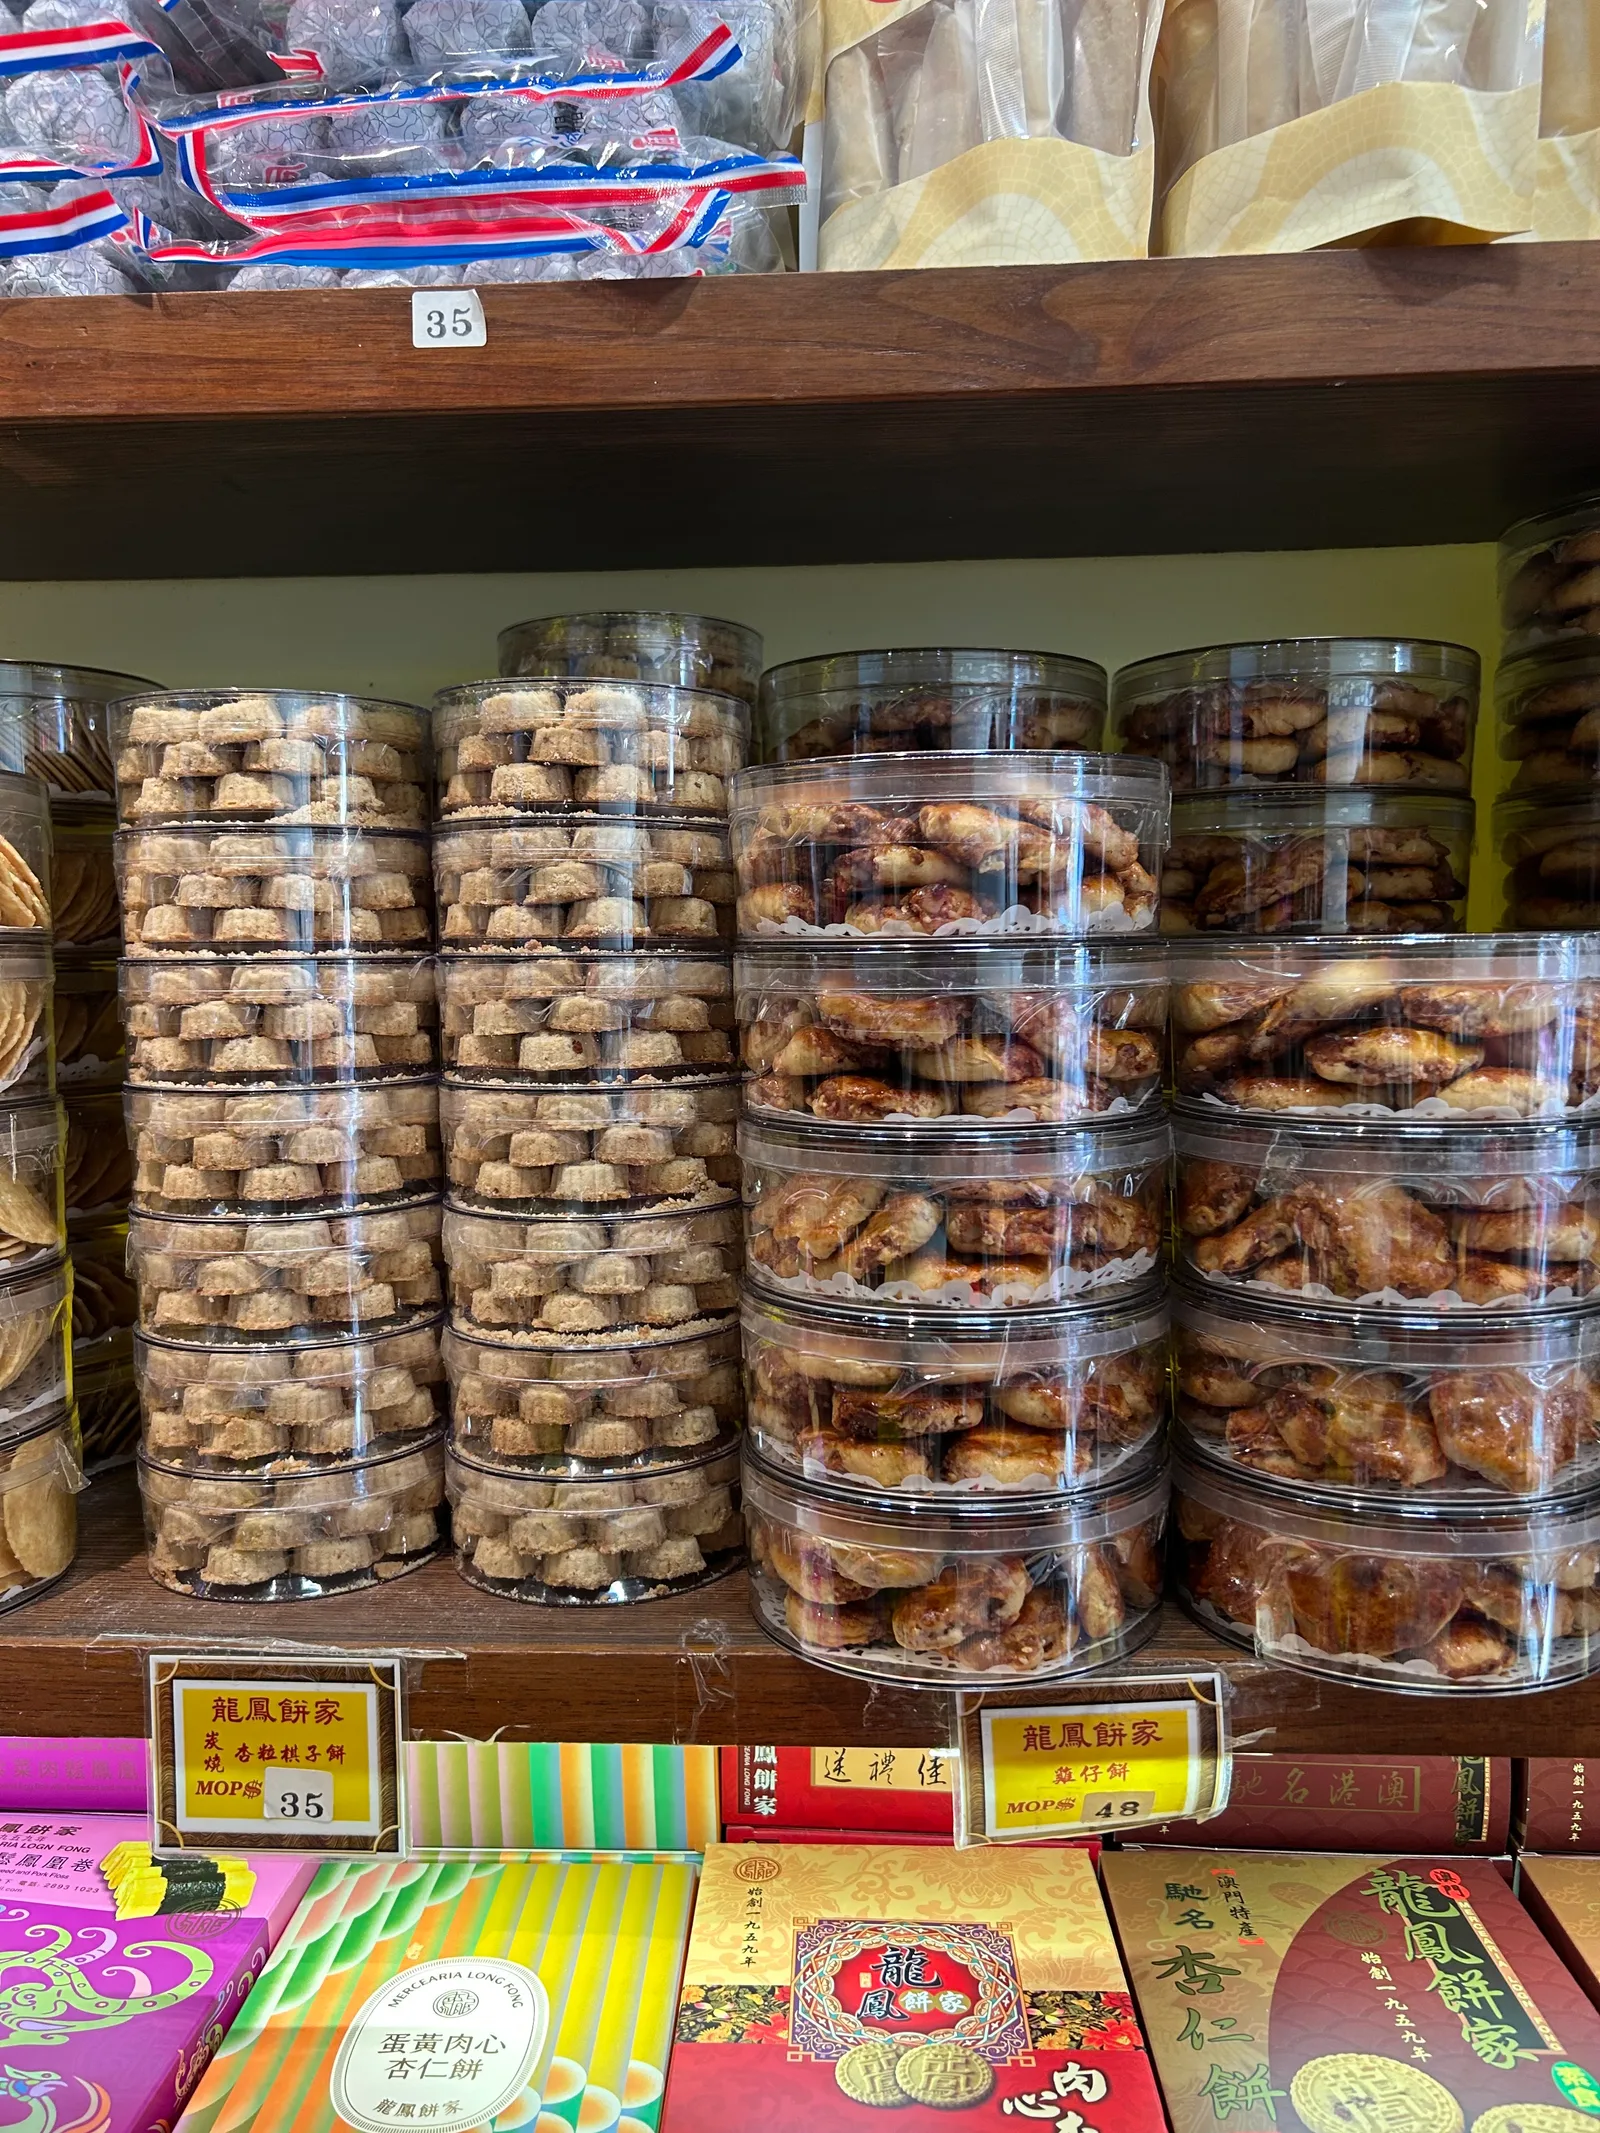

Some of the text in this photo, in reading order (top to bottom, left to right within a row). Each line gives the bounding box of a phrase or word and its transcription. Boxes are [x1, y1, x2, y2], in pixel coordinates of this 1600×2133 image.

[427, 308, 473, 339] 35
[211, 1696, 345, 1726] 龍鳳餅家
[1022, 1719, 1164, 1752] 龍鳳餅家
[203, 1730, 225, 1773] 炭燒
[234, 1742, 347, 1766] 杏粒棋子餅
[280, 1792, 324, 1819] 35
[1094, 1801, 1140, 1819] 48
[1568, 1762, 1586, 1843] 始創一九五九年
[20, 1842, 55, 1851] LOGN
[57, 1845, 92, 1854] FONG
[43, 1882, 70, 1891] 2893
[74, 1885, 100, 1894] 1023
[740, 1887, 763, 1969] 始創一九五九年
[1360, 1868, 1540, 2071] 龍鳳餅家
[387, 1970, 463, 2009] MERCEARIA
[467, 1970, 507, 1986] LONG
[502, 1980, 525, 2010] FONG
[1360, 1951, 1433, 2064] 始創一九五九年
[377, 2032, 507, 2055] 蛋黃肉心
[384, 2057, 484, 2081] 杏仁餅
[372, 2098, 464, 2119] 龍鳳餅家
